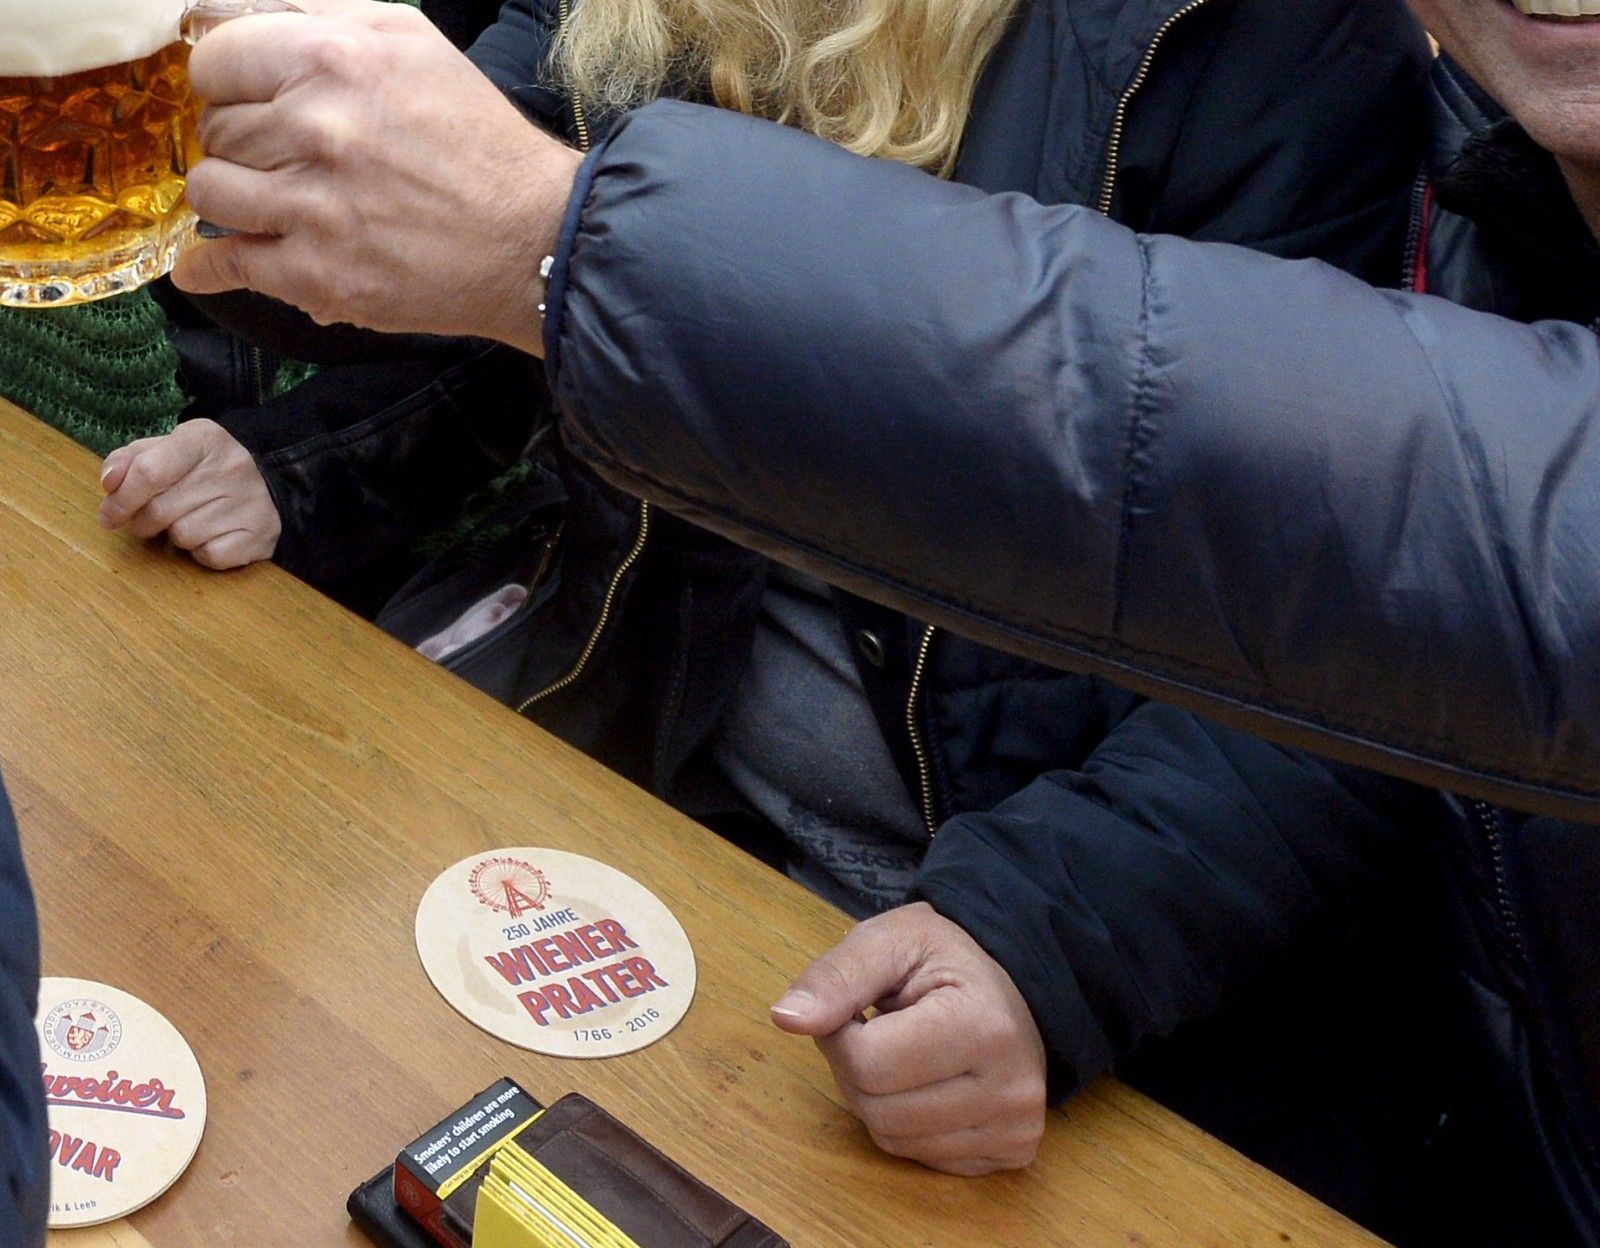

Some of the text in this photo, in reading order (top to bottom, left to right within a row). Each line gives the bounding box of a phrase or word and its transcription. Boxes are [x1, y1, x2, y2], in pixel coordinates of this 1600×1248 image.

[484, 918, 639, 986] WIENER
[503, 907, 579, 941] 250 JAHRE
[517, 956, 669, 1027] PRATER
[573, 1028, 612, 1042] 1766
[626, 1008, 660, 1033] 2016
[41, 1063, 185, 1120] weiser
[414, 1086, 520, 1164] Smokers' children are more
[424, 1153, 452, 1175] likely
[448, 1147, 460, 1157] to
[459, 1131, 480, 1150] start
[478, 1108, 515, 1137] smoking
[65, 1203, 70, 1211] &
[74, 1200, 96, 1212] Leeb
